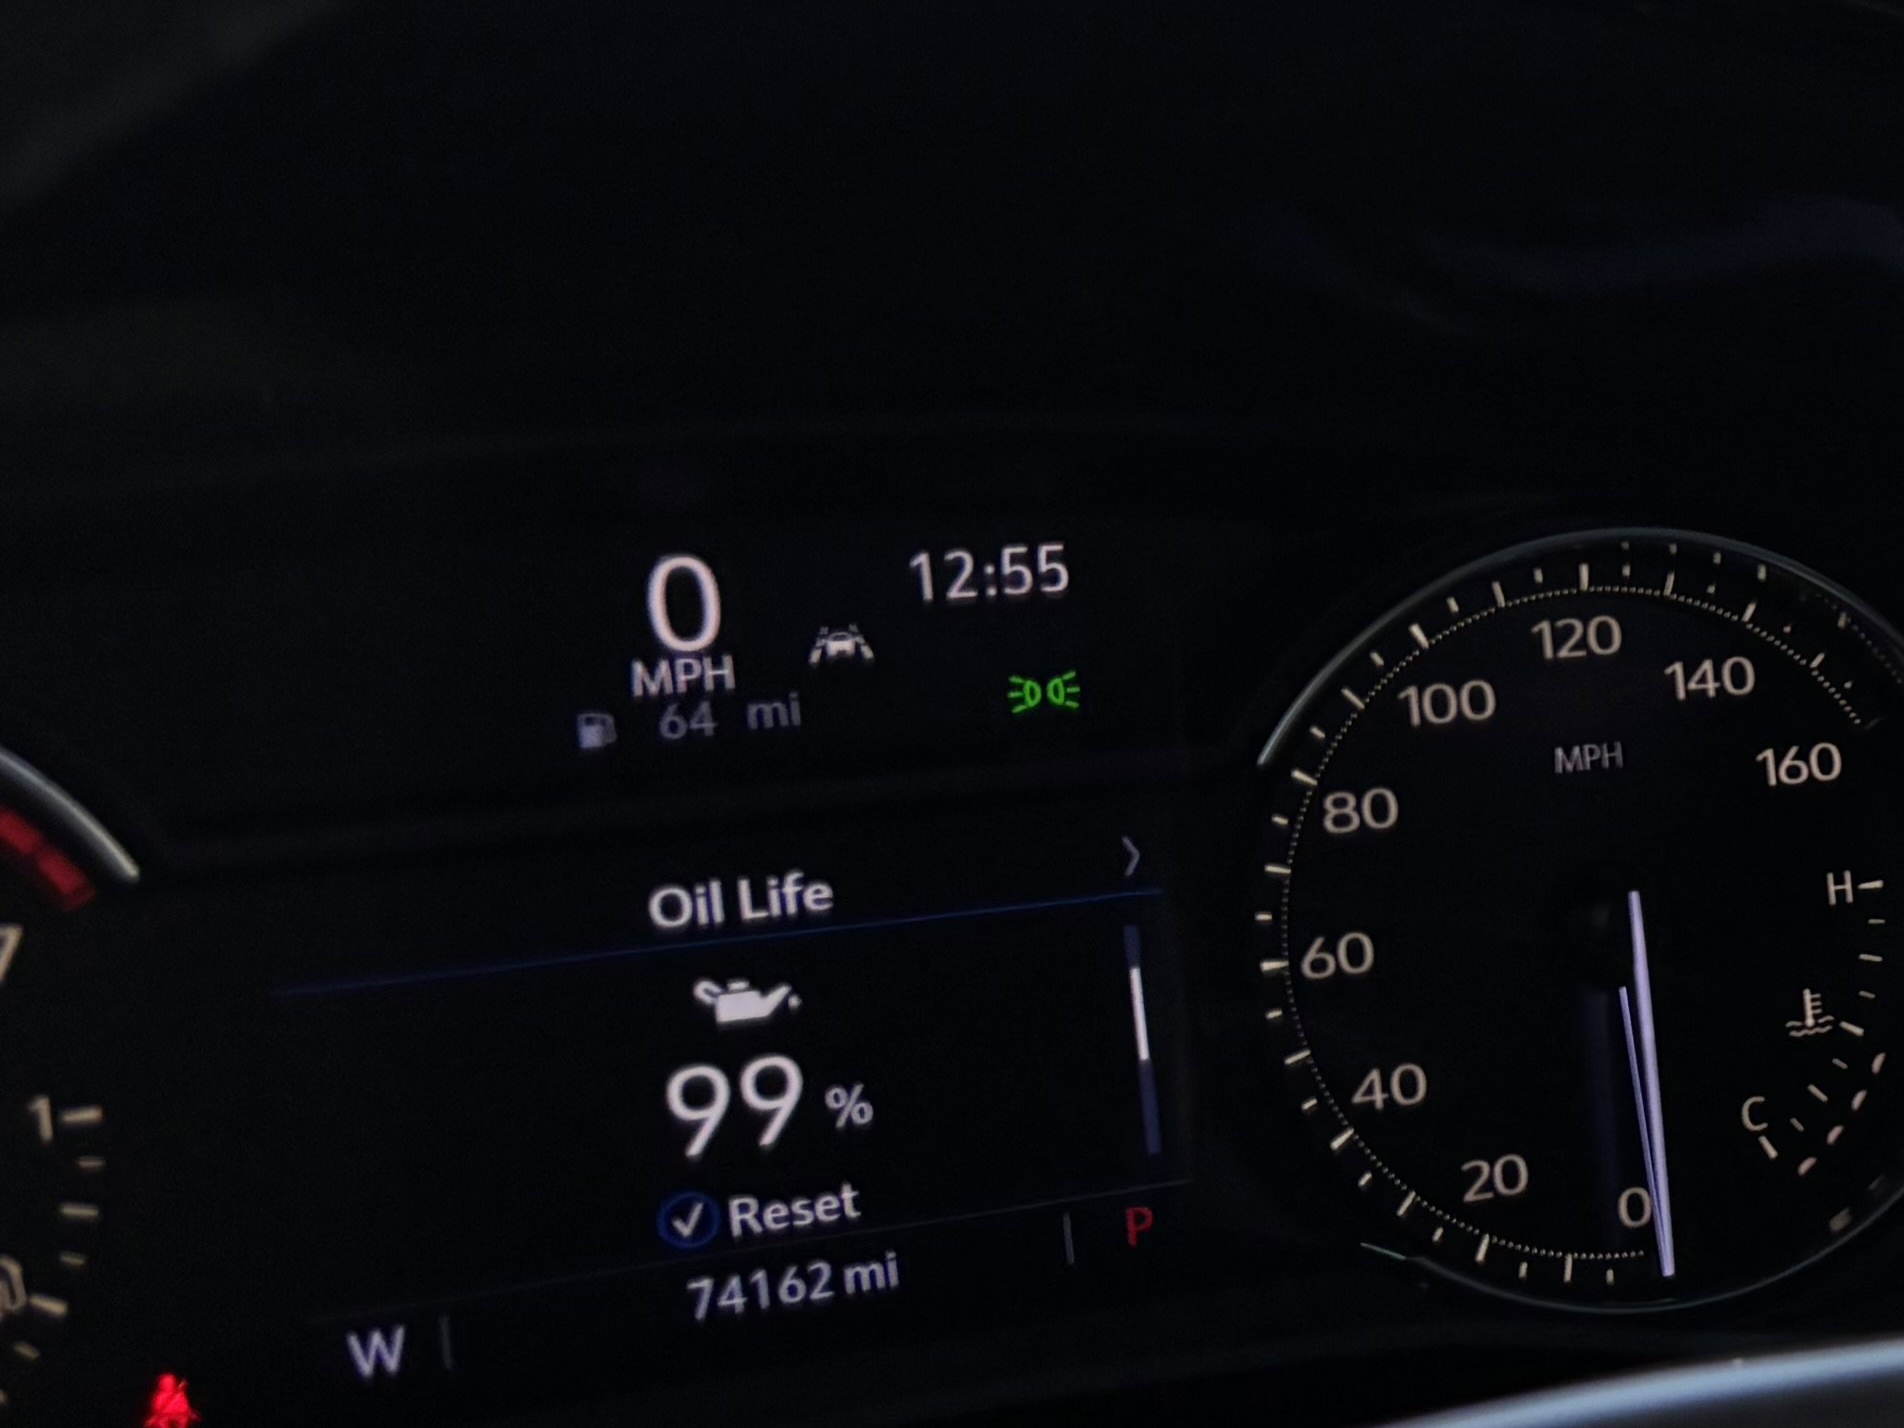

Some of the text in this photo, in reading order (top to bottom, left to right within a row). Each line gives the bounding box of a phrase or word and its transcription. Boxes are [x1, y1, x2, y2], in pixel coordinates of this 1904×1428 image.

[909, 543, 1070, 602] 12:55
[647, 555, 722, 653] 0
[1531, 615, 1622, 660] 120
[632, 655, 735, 698] MPH
[1664, 656, 1755, 701] 140
[660, 692, 801, 740] 64 mi
[1400, 679, 1496, 727] 100
[1554, 742, 1623, 774] MPH
[1756, 742, 1842, 787] 160
[1322, 787, 1399, 834] 80
[648, 871, 833, 929] Oil Life
[1826, 870, 1854, 905] H
[1301, 932, 1374, 979] 60
[666, 1055, 874, 1157] 99 %
[1352, 1063, 1427, 1110] 40
[29, 1097, 53, 1141] 1
[1740, 1095, 1770, 1132] C
[1461, 1154, 1529, 1202] 20
[729, 1184, 861, 1238] Reset
[1125, 1206, 1154, 1246] P
[1618, 1185, 1652, 1229] 0
[687, 1251, 899, 1320] 74162 mi
[347, 1326, 405, 1378] W
